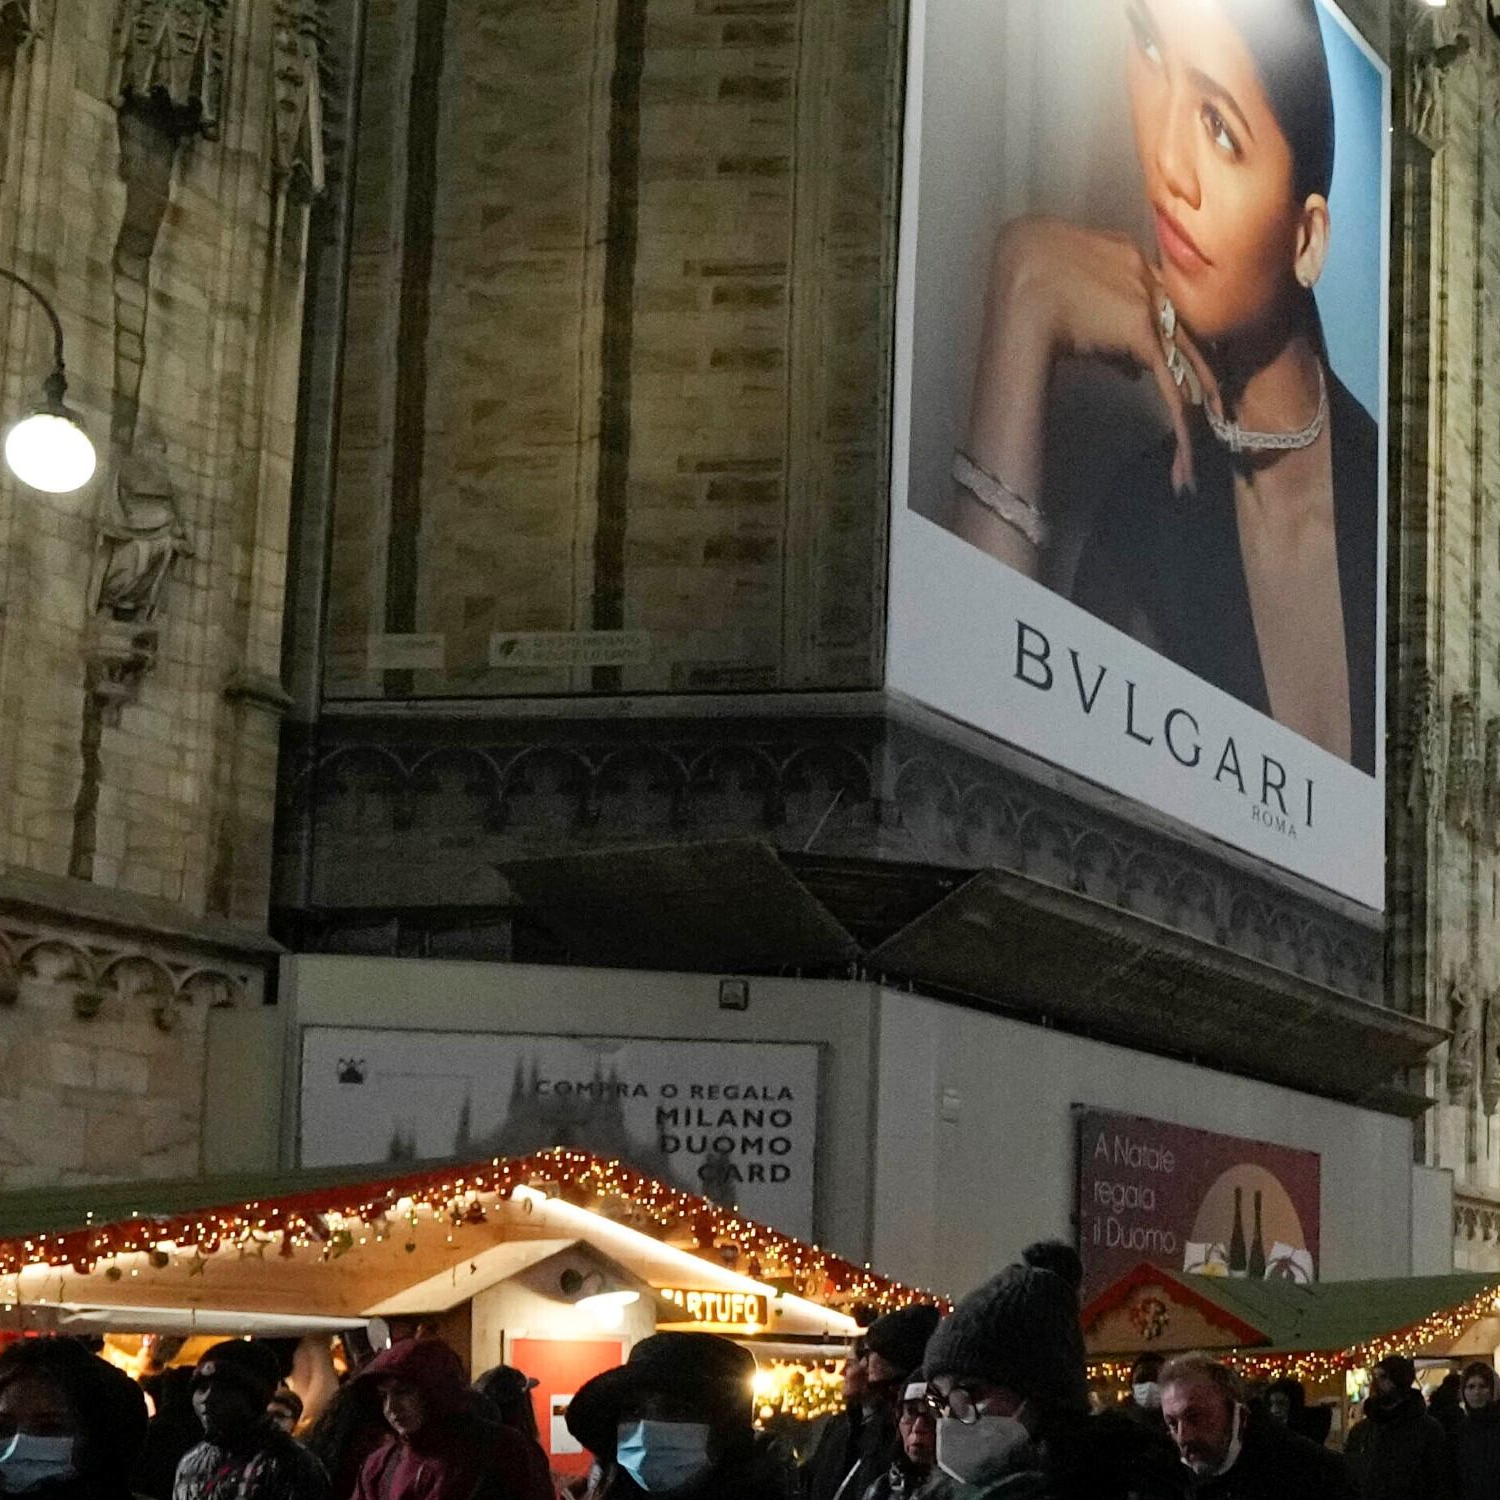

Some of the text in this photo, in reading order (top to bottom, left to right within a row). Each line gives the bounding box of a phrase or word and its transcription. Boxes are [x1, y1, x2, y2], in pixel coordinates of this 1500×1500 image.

[1012, 620, 1315, 828] BVLGARI
[1252, 805, 1297, 839] ROMA
[534, 1079, 794, 1101] COMPRA O REGALA
[656, 1107, 792, 1128] MILANO
[660, 1136, 793, 1156] DUOMO
[1095, 1132, 1175, 1172] A Natale
[697, 1163, 792, 1184] CARD
[1094, 1179, 1155, 1214] regala
[1107, 1217, 1176, 1253] Duomo
